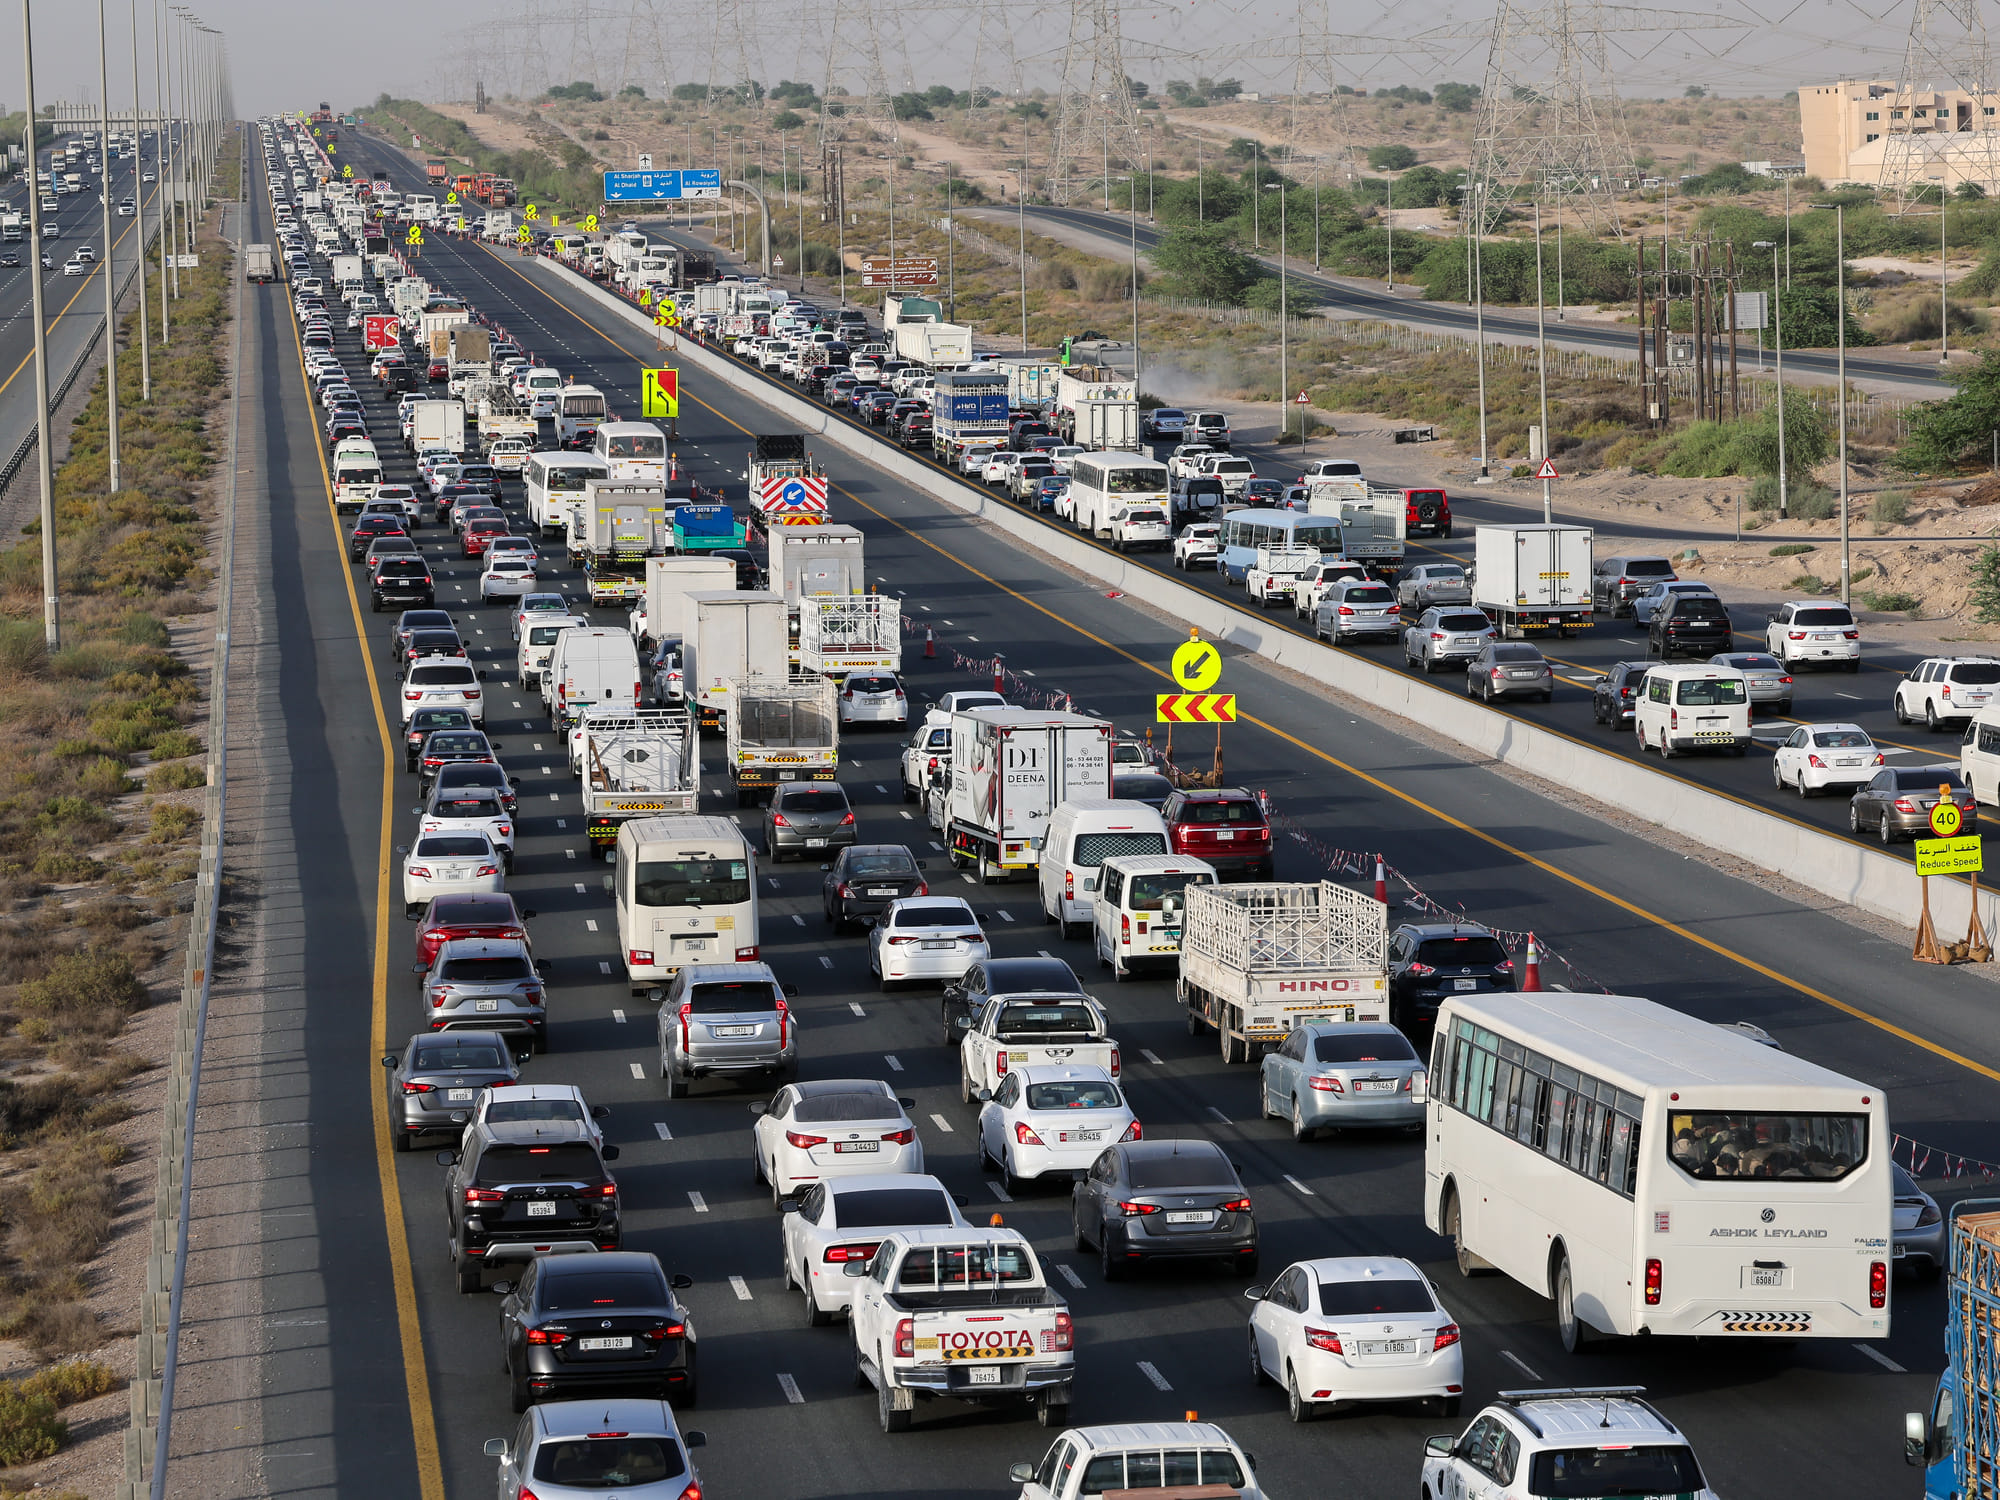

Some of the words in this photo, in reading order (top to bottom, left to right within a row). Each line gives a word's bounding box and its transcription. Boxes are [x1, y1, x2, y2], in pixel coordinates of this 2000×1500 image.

[1008, 774, 1046, 783] DEENA
[1936, 812, 1956, 825] 40
[1918, 843, 1951, 857] السرعة
[1953, 842, 1979, 852] خفف
[1920, 860, 1951, 868] Reduce
[1953, 856, 1979, 867] Speed
[1279, 980, 1349, 992] HINO
[1078, 1131, 1101, 1142] 85415
[854, 1141, 877, 1151] 14413
[1709, 1228, 1758, 1238] ASHOK
[1764, 1227, 1828, 1239] LEYLAND
[1755, 1275, 1776, 1285] 65081
[937, 1330, 1034, 1350] TOYOTA
[975, 1373, 996, 1383] 76475
